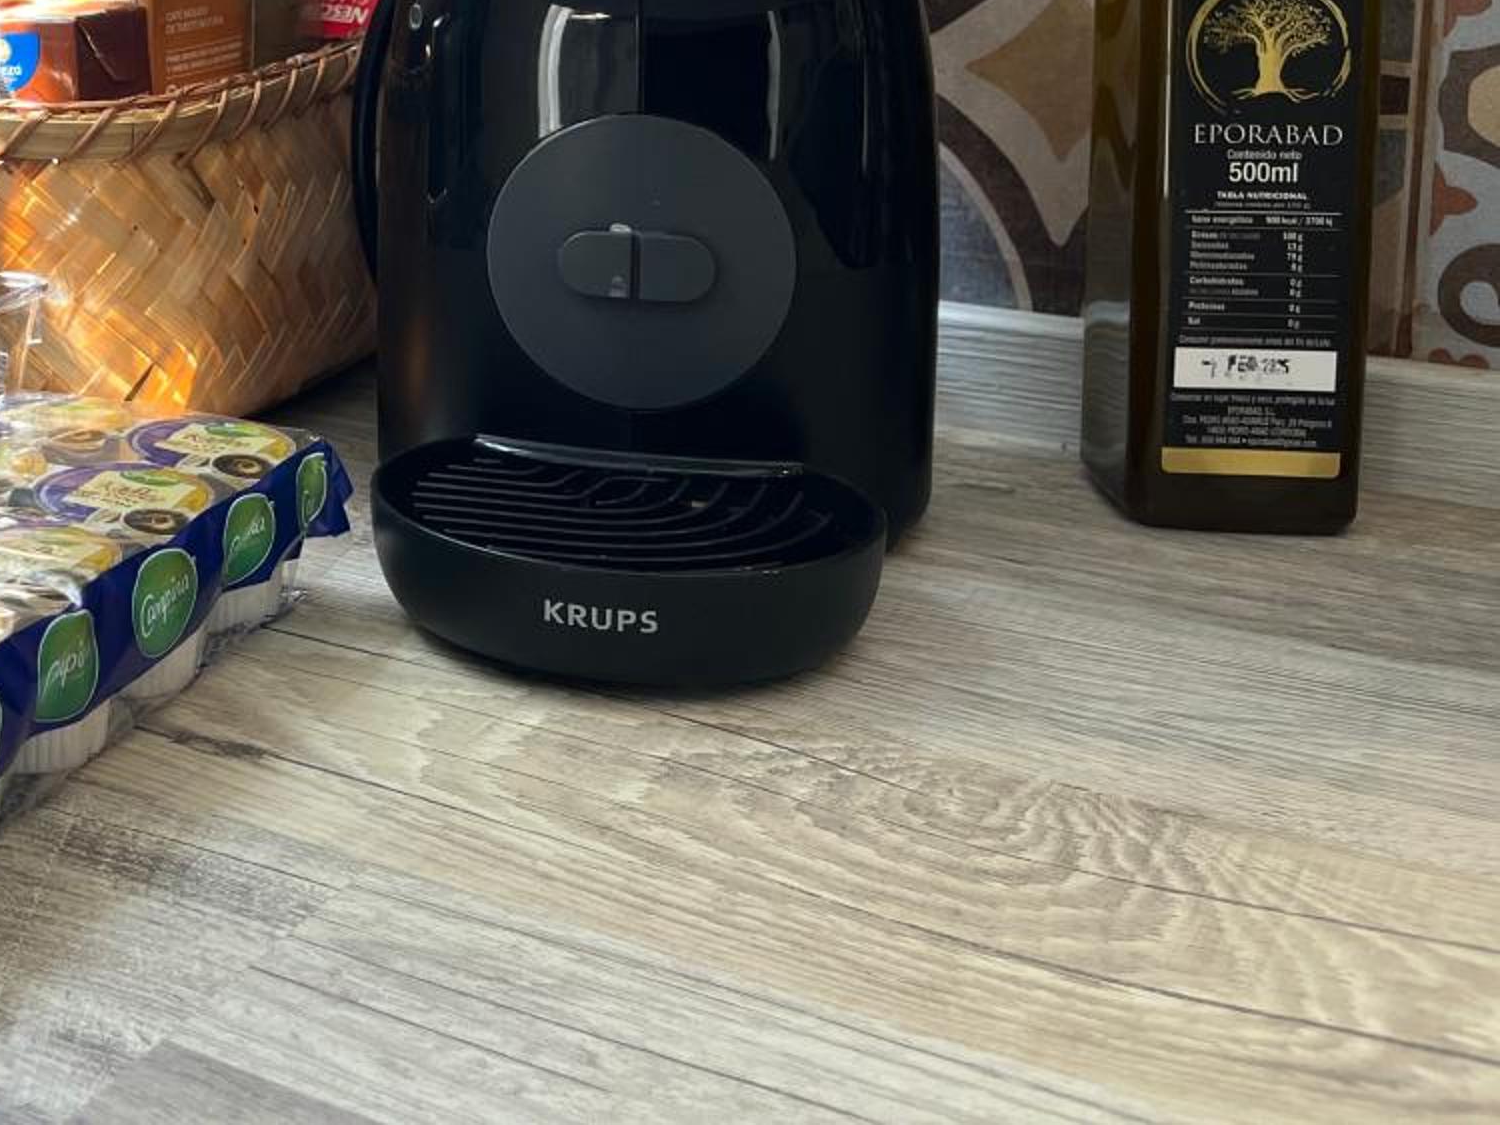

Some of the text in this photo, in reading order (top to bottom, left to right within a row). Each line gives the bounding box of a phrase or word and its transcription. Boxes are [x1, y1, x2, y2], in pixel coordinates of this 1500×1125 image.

[1194, 124, 1344, 147] EPORABAD
[1227, 149, 1302, 160] Contenido neto
[1228, 162, 1299, 183] 500ml
[542, 598, 659, 634] KRUPS
